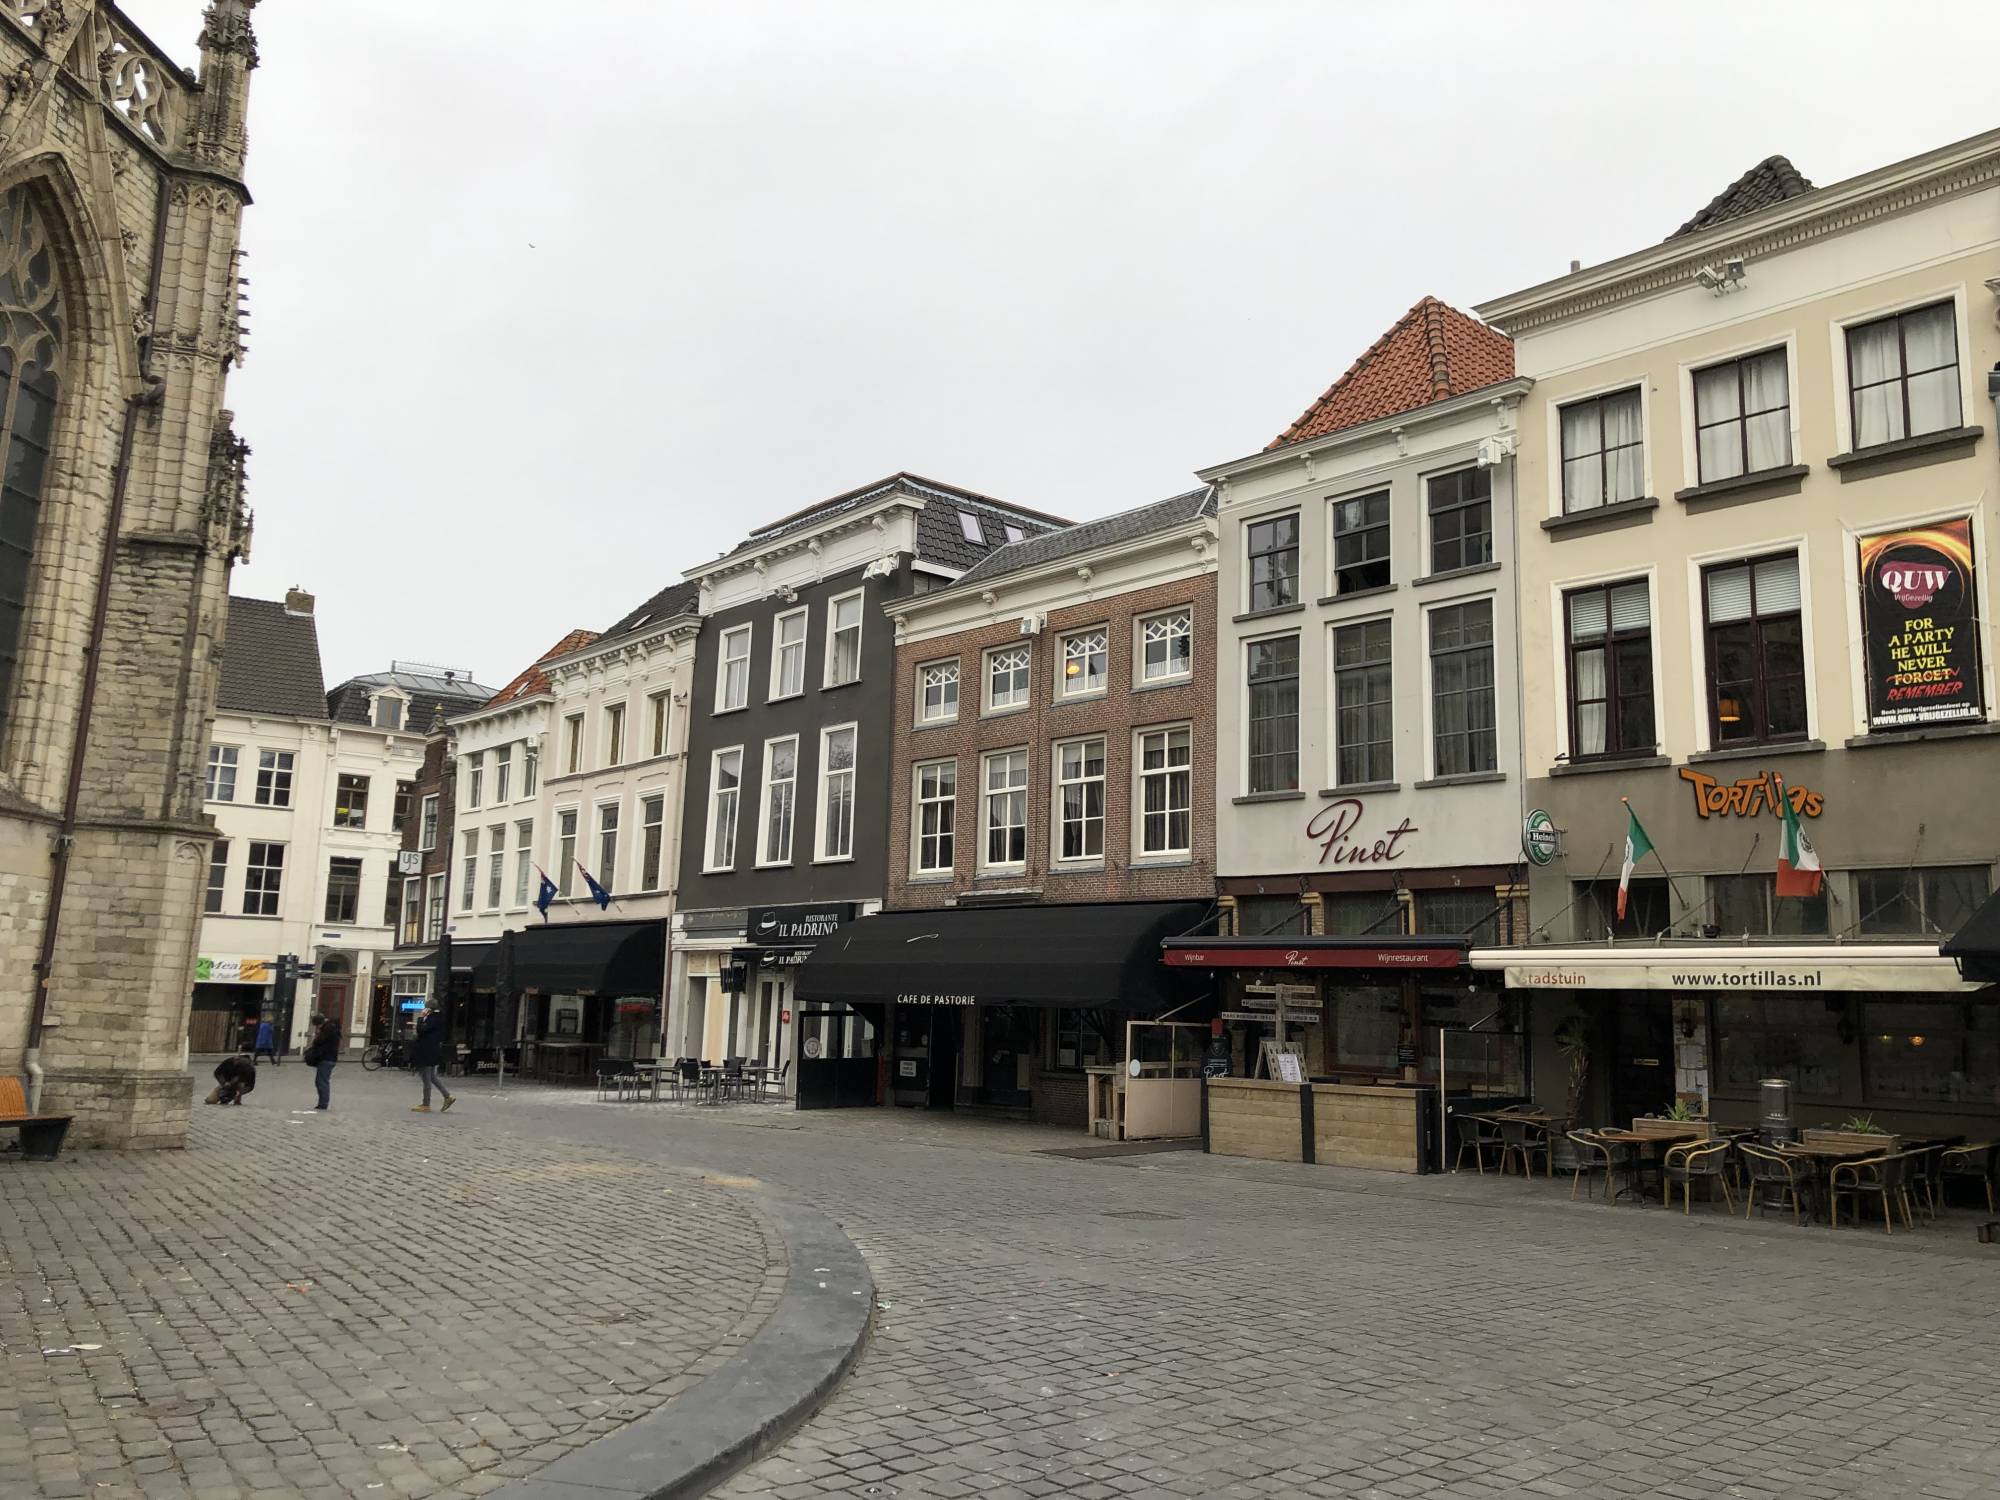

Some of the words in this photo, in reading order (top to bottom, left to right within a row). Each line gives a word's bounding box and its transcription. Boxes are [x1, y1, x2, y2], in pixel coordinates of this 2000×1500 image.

[1882, 570, 1952, 593] QUW
[1904, 617, 1934, 632] FOR
[1888, 635, 1901, 647] A
[1903, 626, 1954, 645] PARTY
[1891, 647, 1911, 660] HE
[1913, 642, 1952, 657] WILL
[1898, 655, 1947, 672] NEVER
[1894, 668, 1950, 686] FORGET
[1886, 681, 1964, 701] REMEMBER
[1306, 798, 1419, 865] Pinot
[1532, 831, 1556, 842] Hein
[805, 913, 839, 923] RISTORANTE
[778, 923, 789, 937] IL
[1377, 953, 1429, 964] Wijnrestaurant
[1521, 971, 1586, 985] stadstuin
[1671, 970, 1822, 986] www.tortillas.nl
[897, 994, 918, 1005] CAFE
[920, 995, 931, 1005] DE
[934, 995, 976, 1006] PASTORIE
